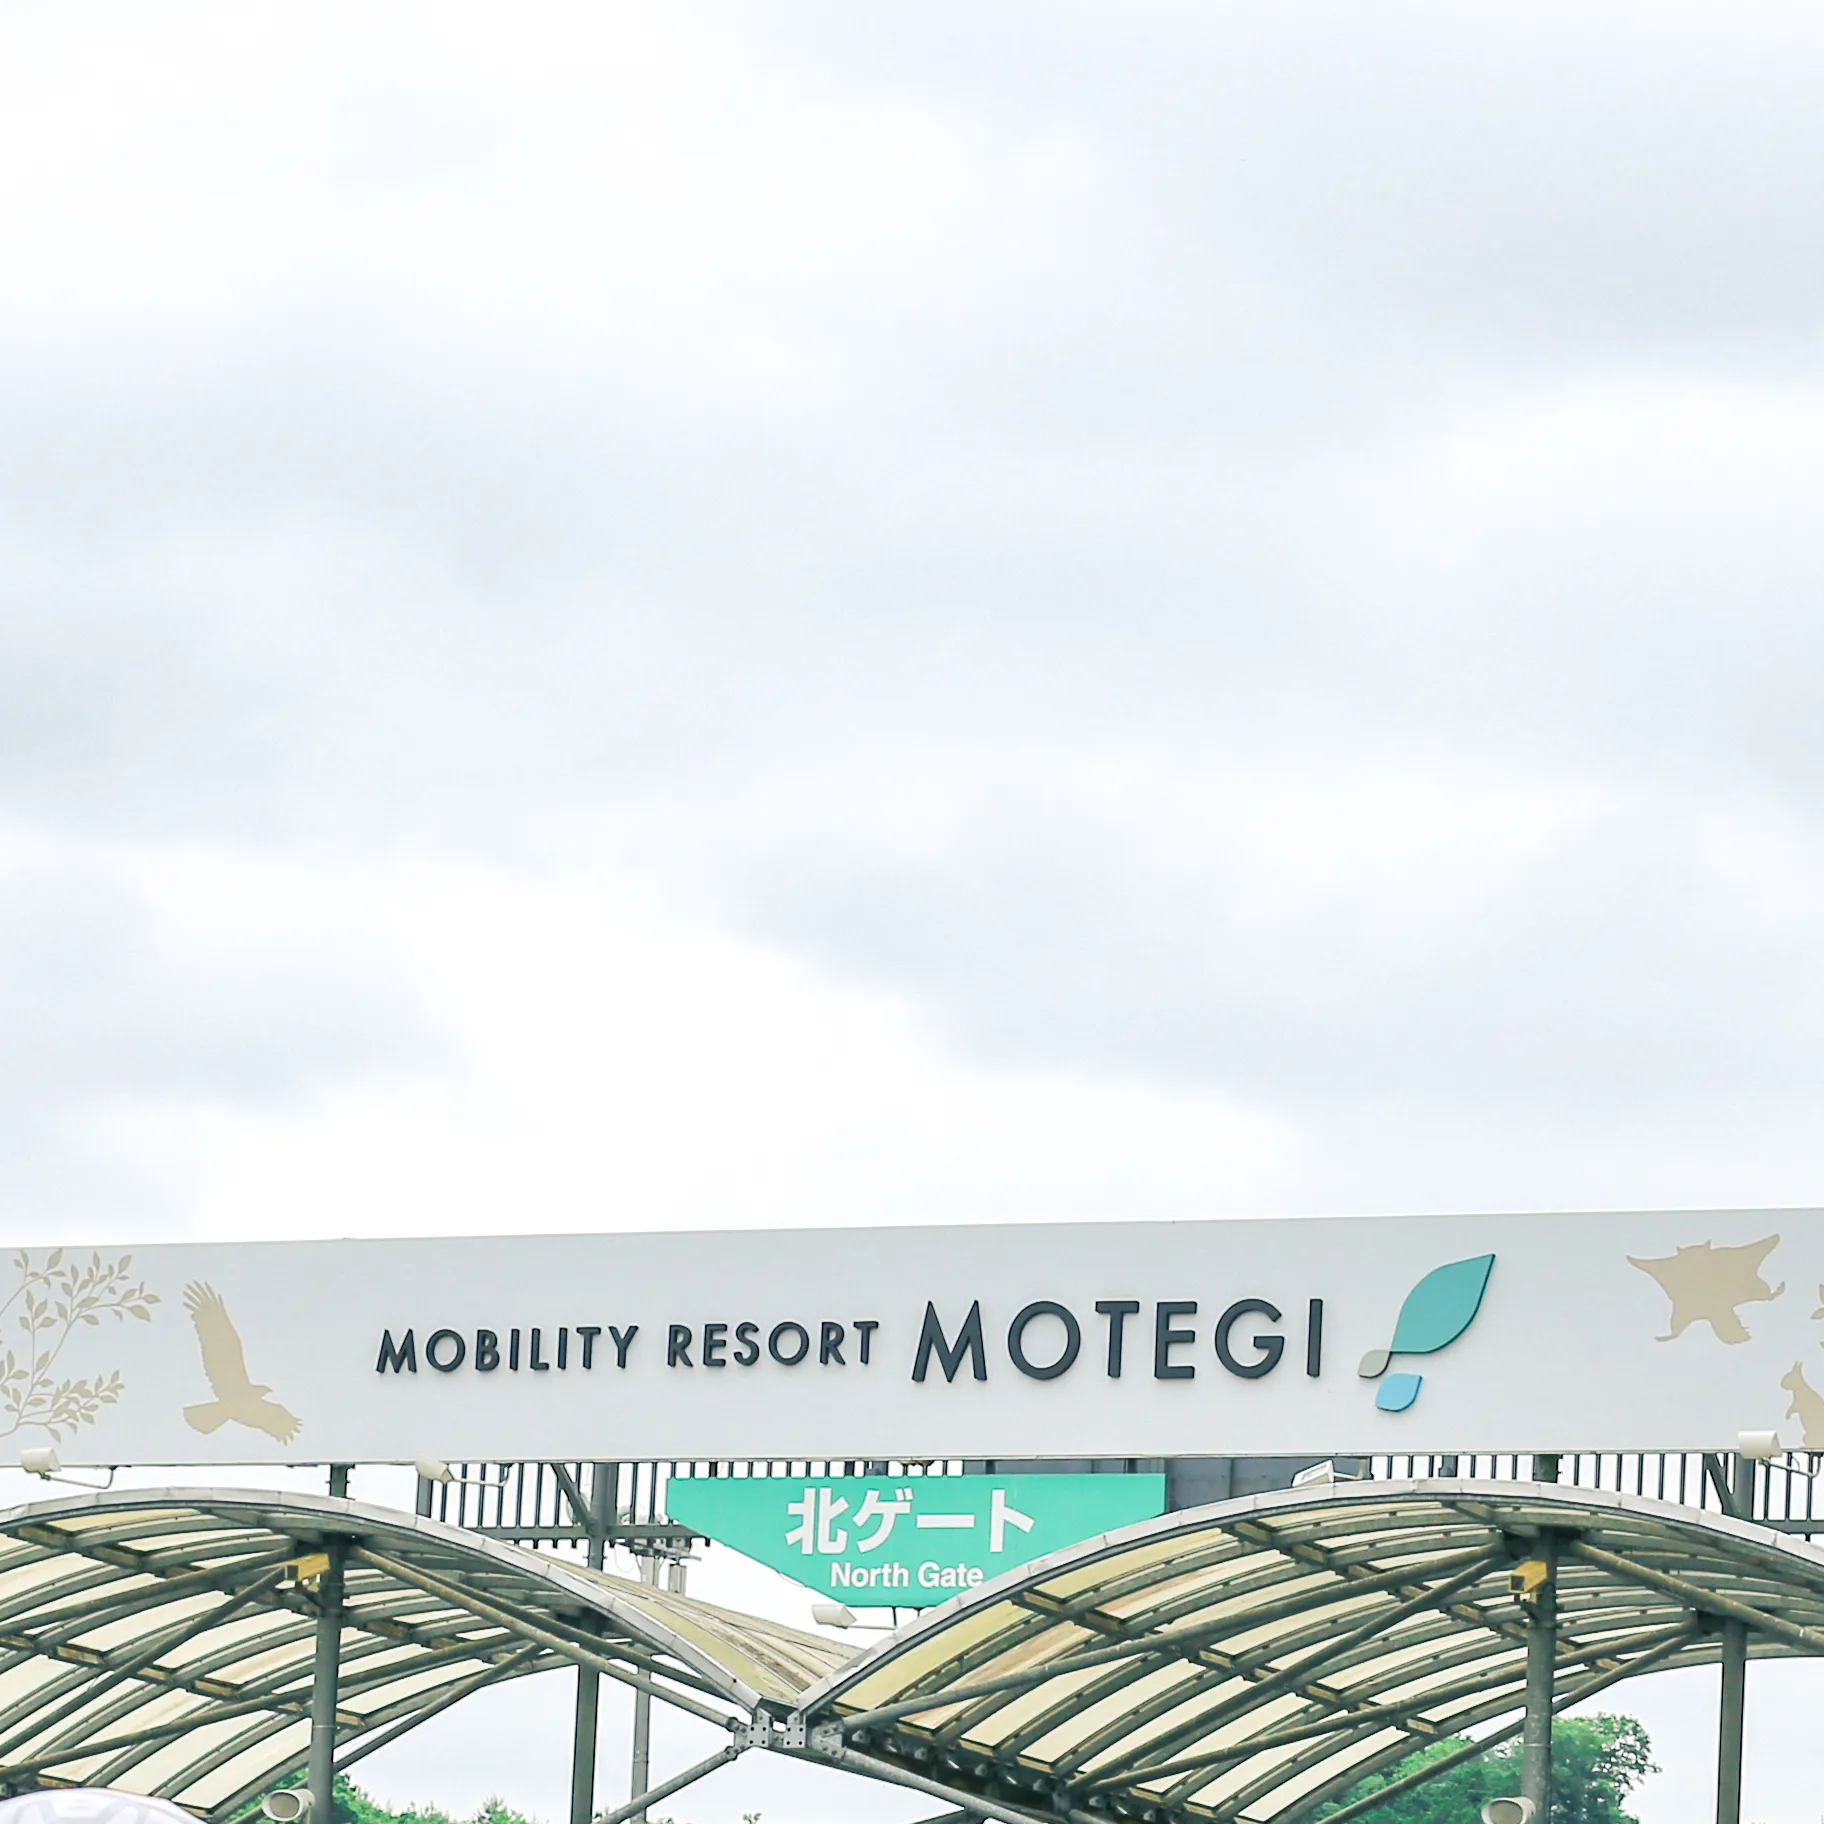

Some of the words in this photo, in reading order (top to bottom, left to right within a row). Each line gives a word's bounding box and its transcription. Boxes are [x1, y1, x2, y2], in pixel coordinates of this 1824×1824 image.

[376, 1326, 638, 1373] MOBILITY
[667, 1321, 879, 1368] RESORT
[911, 1298, 1324, 1383] MOTEGI
[784, 1487, 1035, 1554] 北ゲート
[831, 1560, 911, 1588] North
[917, 1560, 984, 1588] Gate
